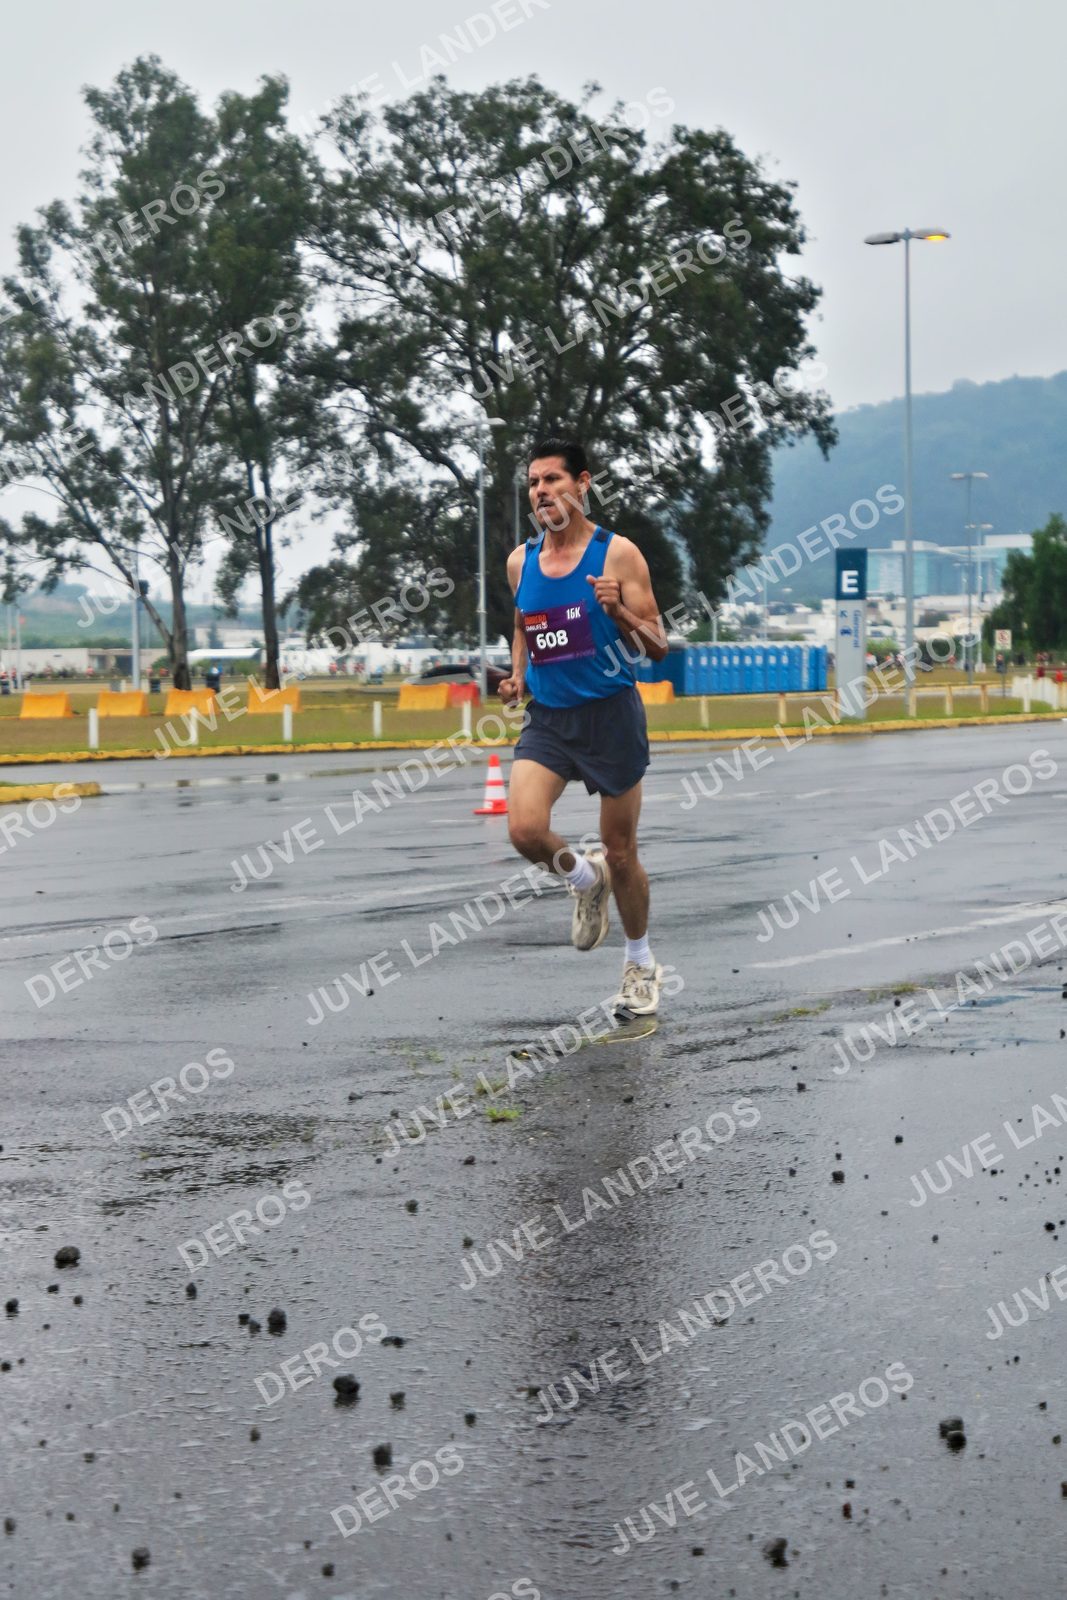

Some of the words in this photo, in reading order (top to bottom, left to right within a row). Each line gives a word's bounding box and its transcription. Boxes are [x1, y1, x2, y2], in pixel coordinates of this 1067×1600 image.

[841, 570, 860, 593] E
[566, 606, 582, 620] 16K
[536, 629, 569, 650] 608
